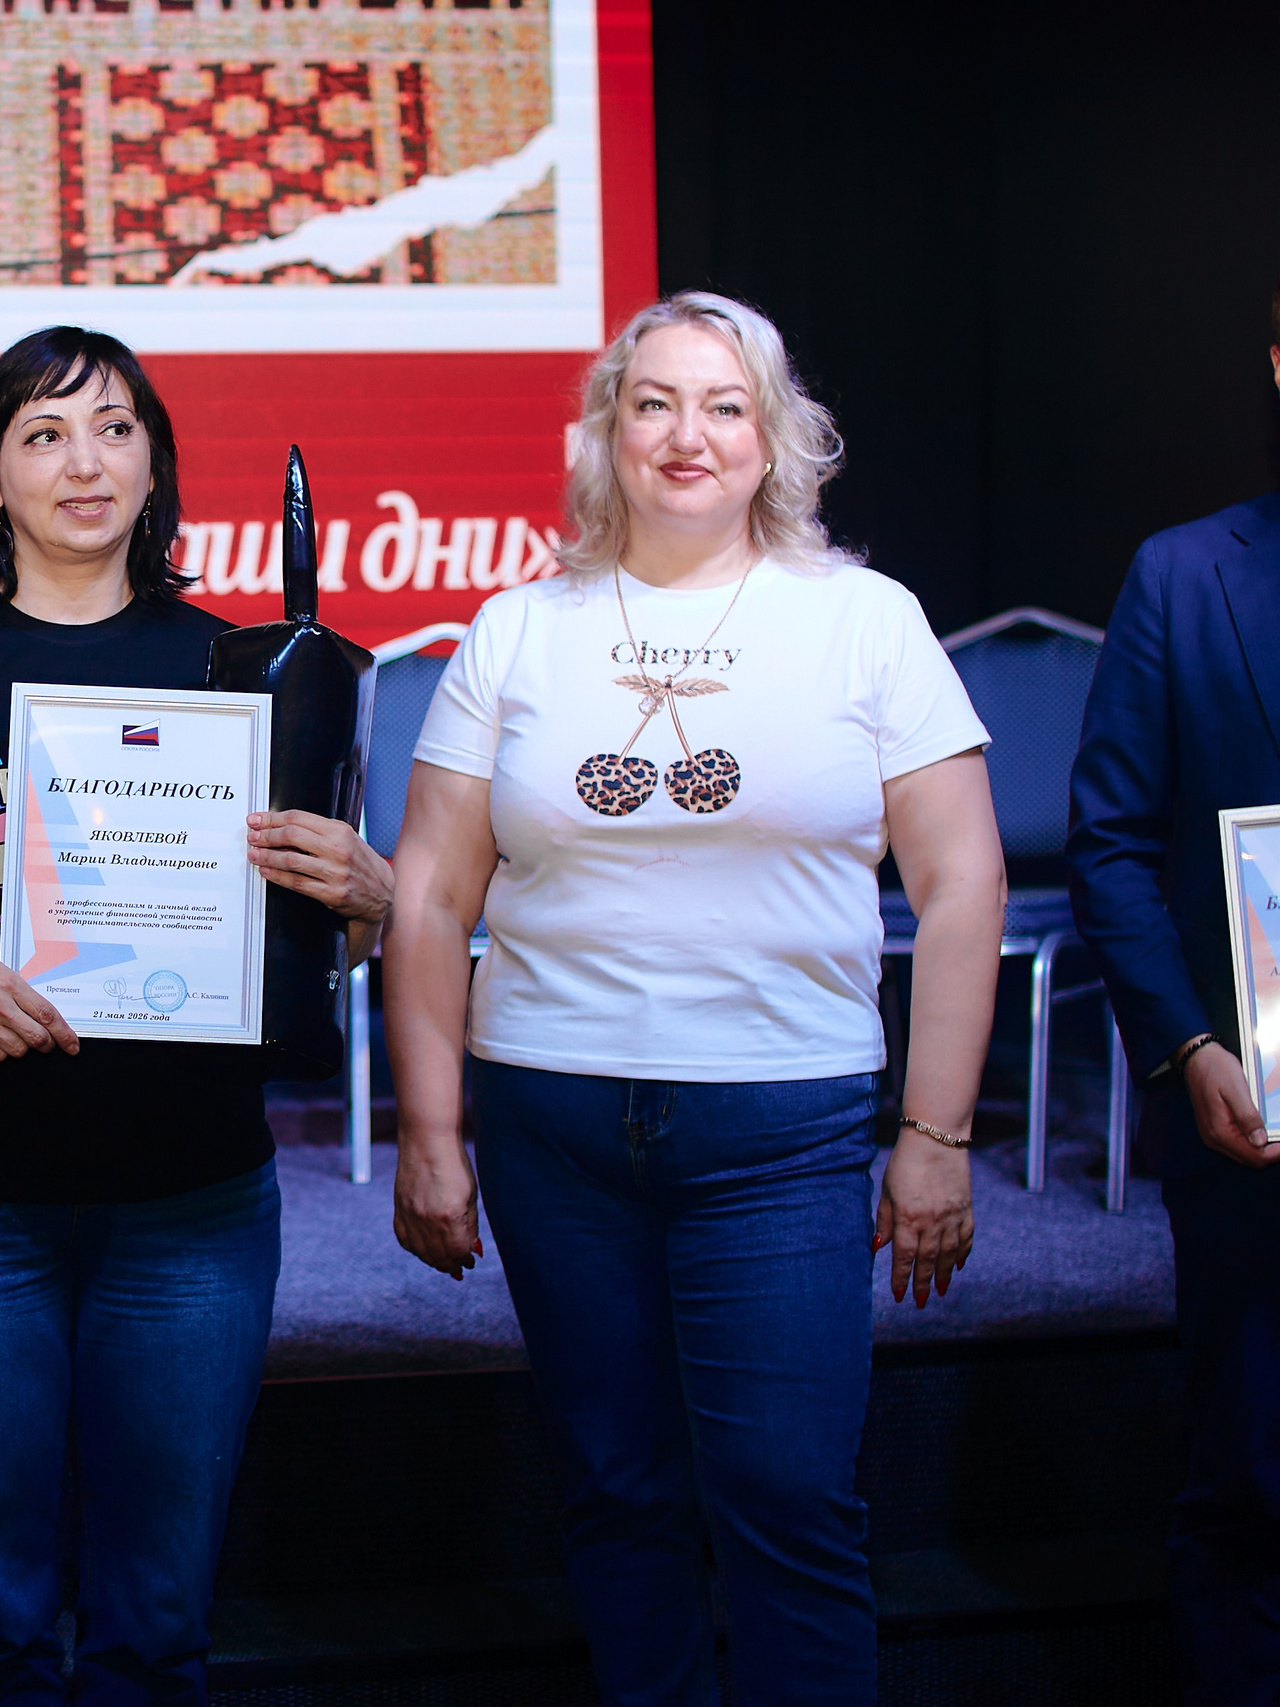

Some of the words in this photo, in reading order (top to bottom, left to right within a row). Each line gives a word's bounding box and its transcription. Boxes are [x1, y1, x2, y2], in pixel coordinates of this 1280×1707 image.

[610, 640, 742, 672] Cherry
[47, 777, 235, 801] БЛАГОДАРНОСТЬ
[89, 830, 188, 845] ЯКОВЛЕВОЙ
[57, 851, 106, 866] Марии
[110, 853, 218, 870] Владимировне
[66, 899, 146, 910] профессионализм
[154, 902, 189, 912] личный
[191, 904, 217, 913] вклад
[54, 909, 104, 918] укрепление
[105, 910, 158, 919] финансовой
[159, 912, 223, 922] устойчивости
[56, 917, 160, 929] предпринимательского
[161, 921, 213, 931] сообщества
[46, 985, 81, 994] Президент
[93, 1011, 103, 1019] 21
[128, 1012, 148, 1021] 2026
[150, 1013, 171, 1022] года
